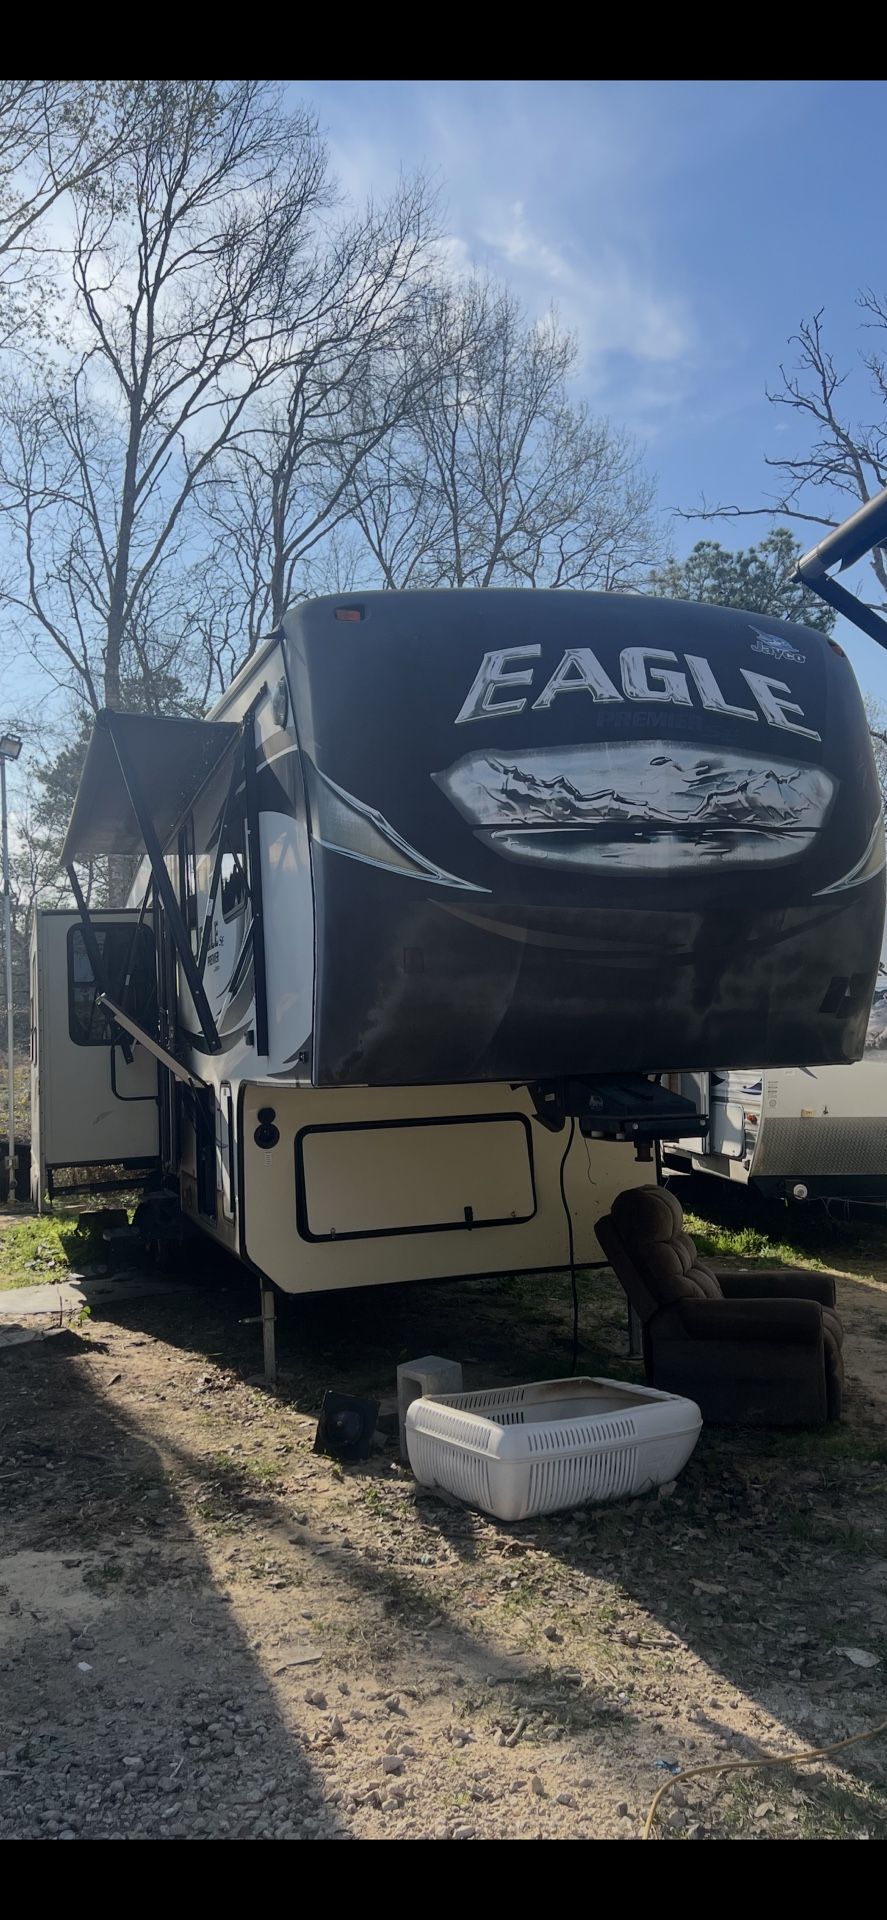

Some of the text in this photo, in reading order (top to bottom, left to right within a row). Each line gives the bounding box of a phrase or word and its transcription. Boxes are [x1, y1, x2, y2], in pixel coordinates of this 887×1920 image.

[750, 640, 806, 664] Jayco
[454, 644, 822, 742] EAGLE
[595, 711, 702, 730] PREMIER
